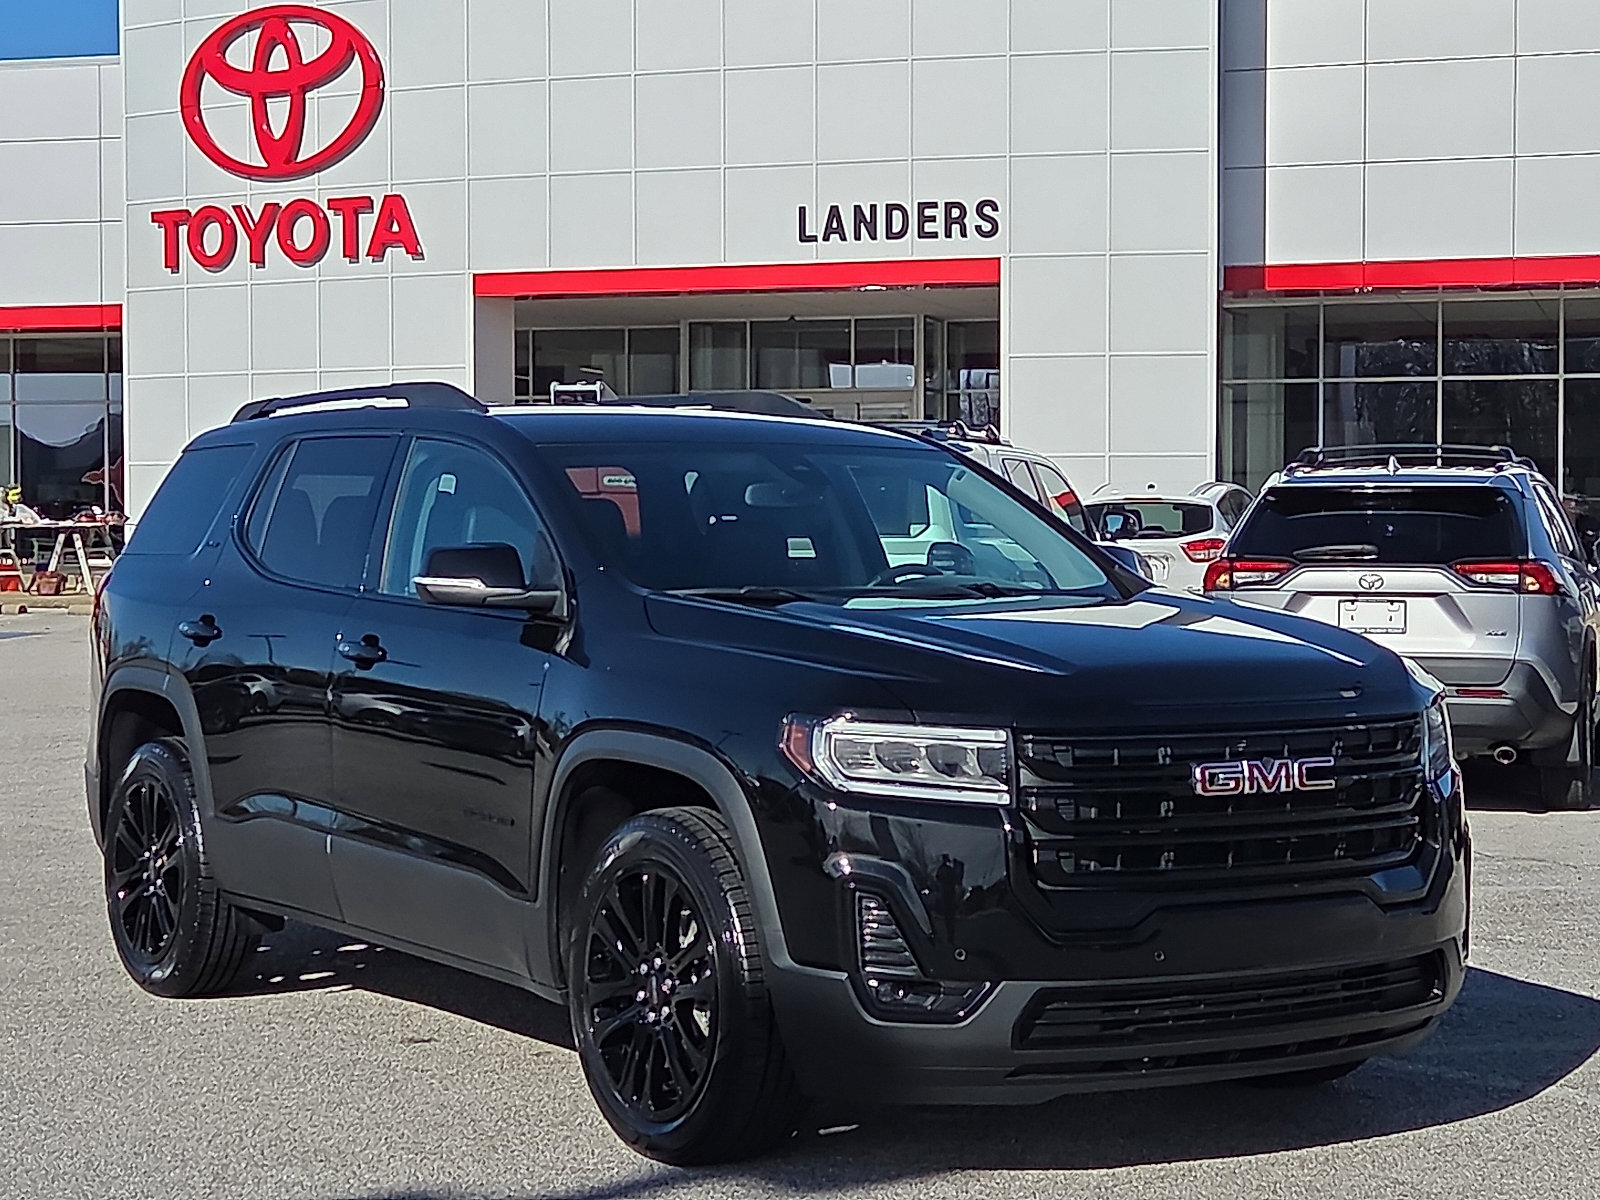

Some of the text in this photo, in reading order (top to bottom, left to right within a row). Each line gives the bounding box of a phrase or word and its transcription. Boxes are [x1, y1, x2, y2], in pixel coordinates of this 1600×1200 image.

[151, 194, 424, 273] TOYOTA
[799, 199, 999, 243] LANDERS
[1194, 757, 1336, 796] GMC
